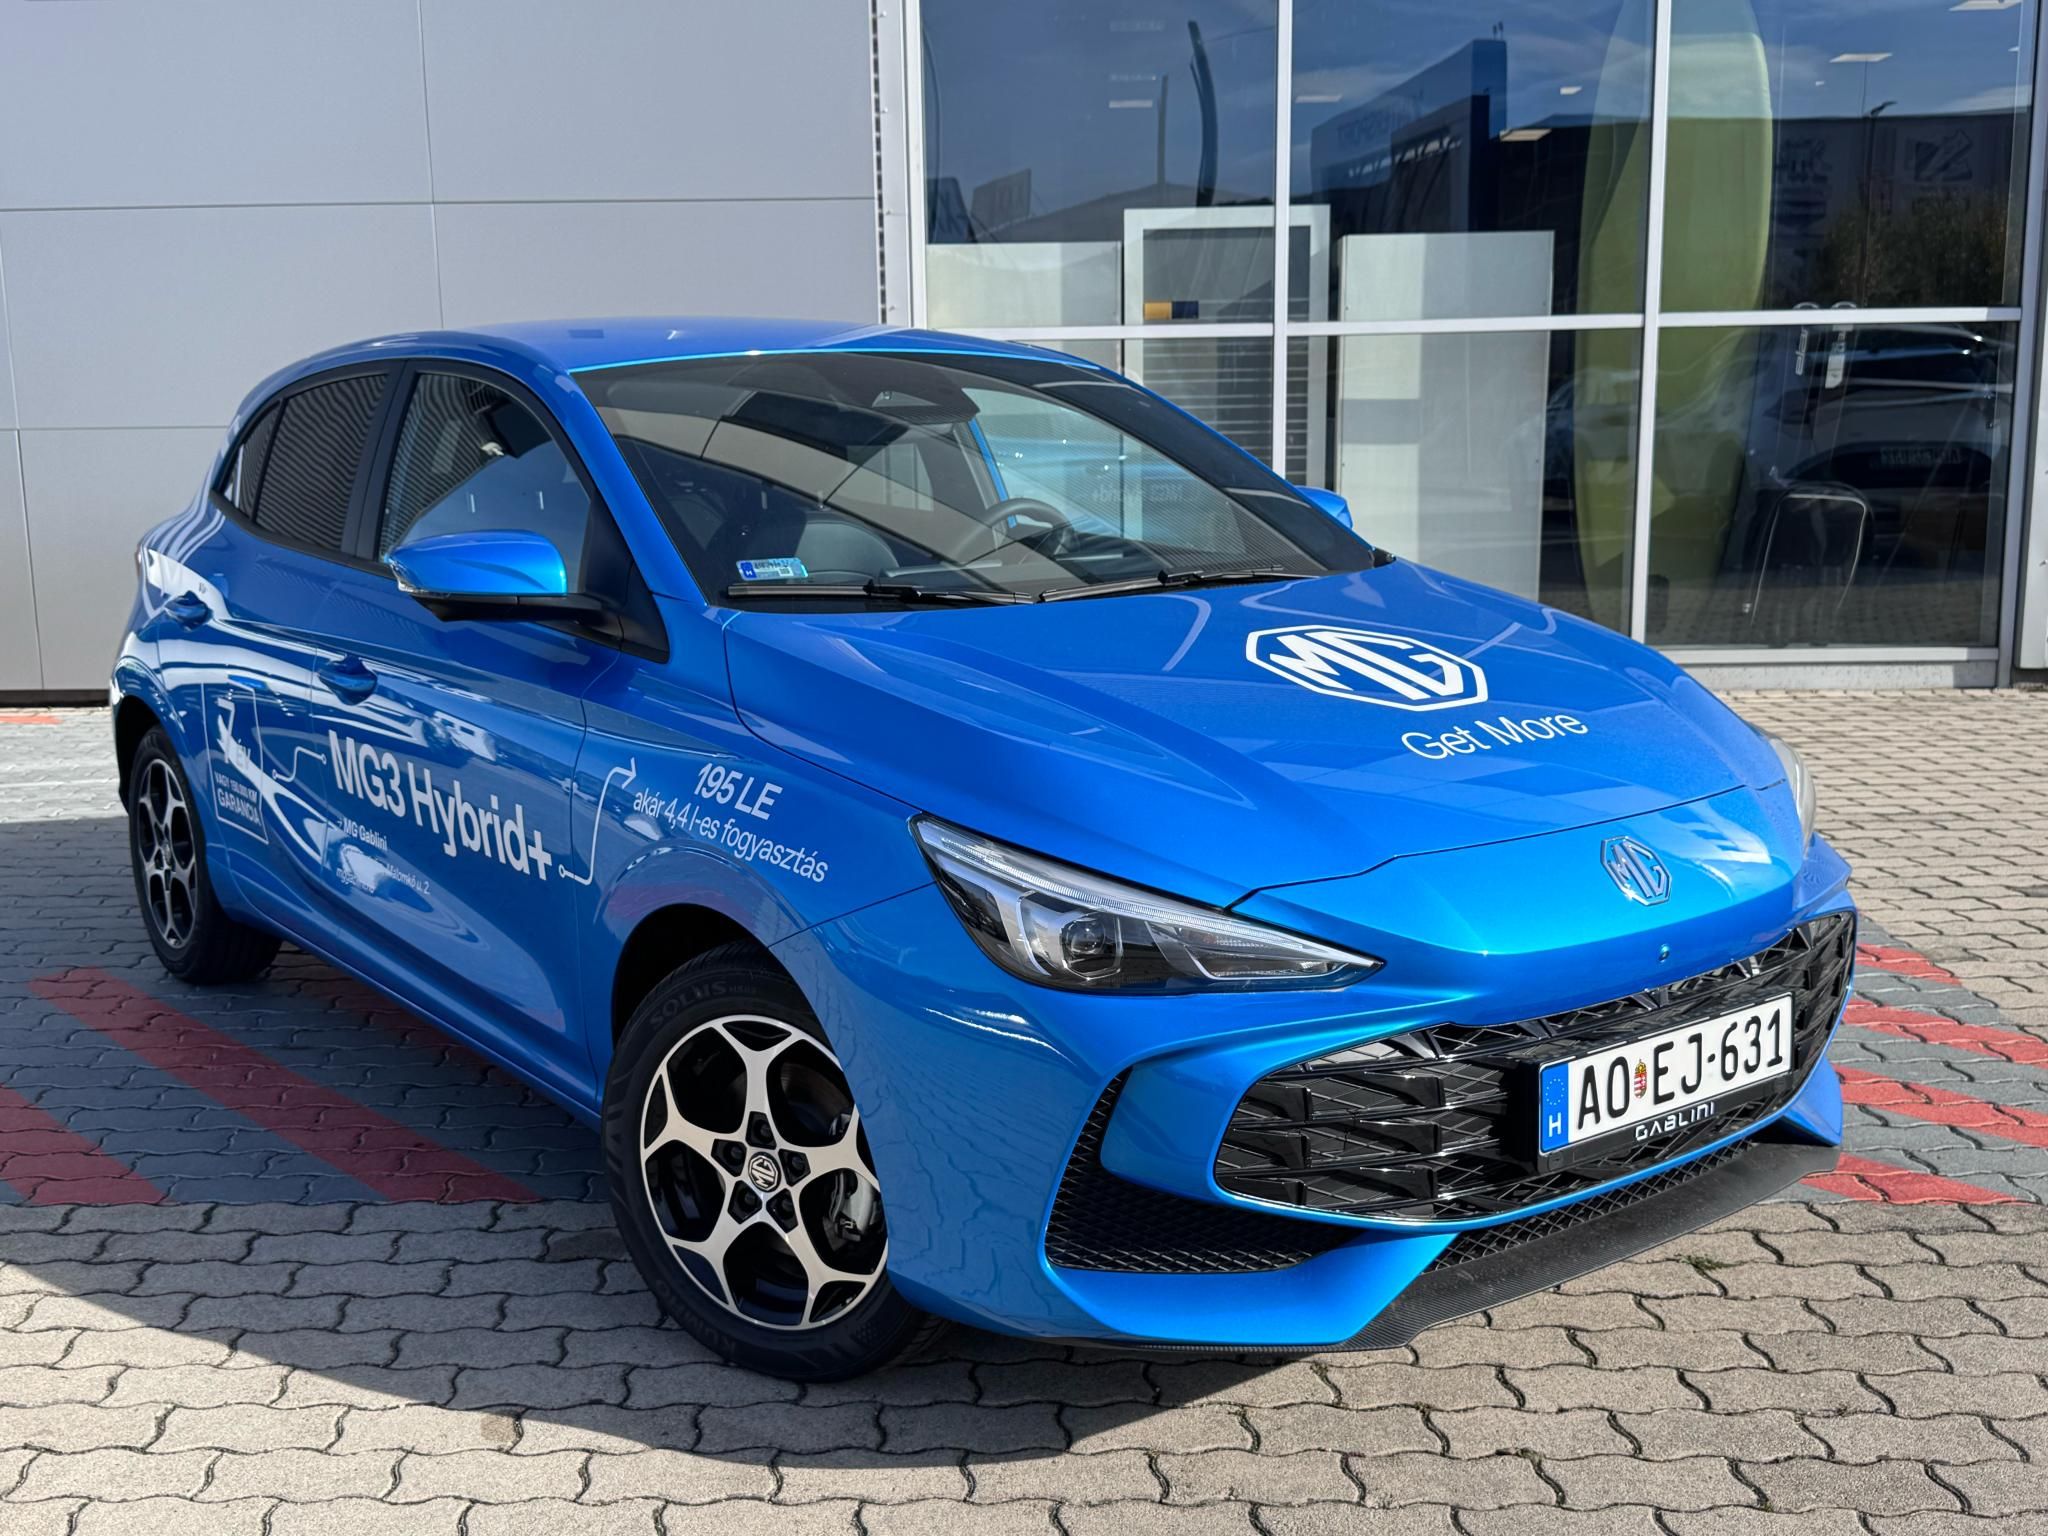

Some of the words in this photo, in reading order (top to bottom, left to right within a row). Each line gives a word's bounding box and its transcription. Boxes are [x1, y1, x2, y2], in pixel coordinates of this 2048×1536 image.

[1270, 632, 1465, 700] MG
[1401, 725, 1492, 760] Get
[1474, 714, 1589, 746] More
[217, 787, 262, 826] GARANCIA
[328, 729, 406, 817] MG3
[408, 761, 553, 881] Hybrid+
[693, 762, 743, 804] 195
[734, 777, 783, 820] LE
[343, 816, 358, 838] MG
[359, 825, 388, 851] Gablini
[632, 787, 665, 819] akár
[664, 797, 691, 831] 4,4
[689, 805, 718, 840] l-es
[720, 818, 829, 883] fogyasztás
[1605, 838, 1669, 900] MG
[1653, 1007, 1784, 1106] EJ-631
[1548, 1112, 1562, 1138] H
[1635, 1101, 1715, 1141] GABLINI
[750, 1156, 778, 1189] MG
